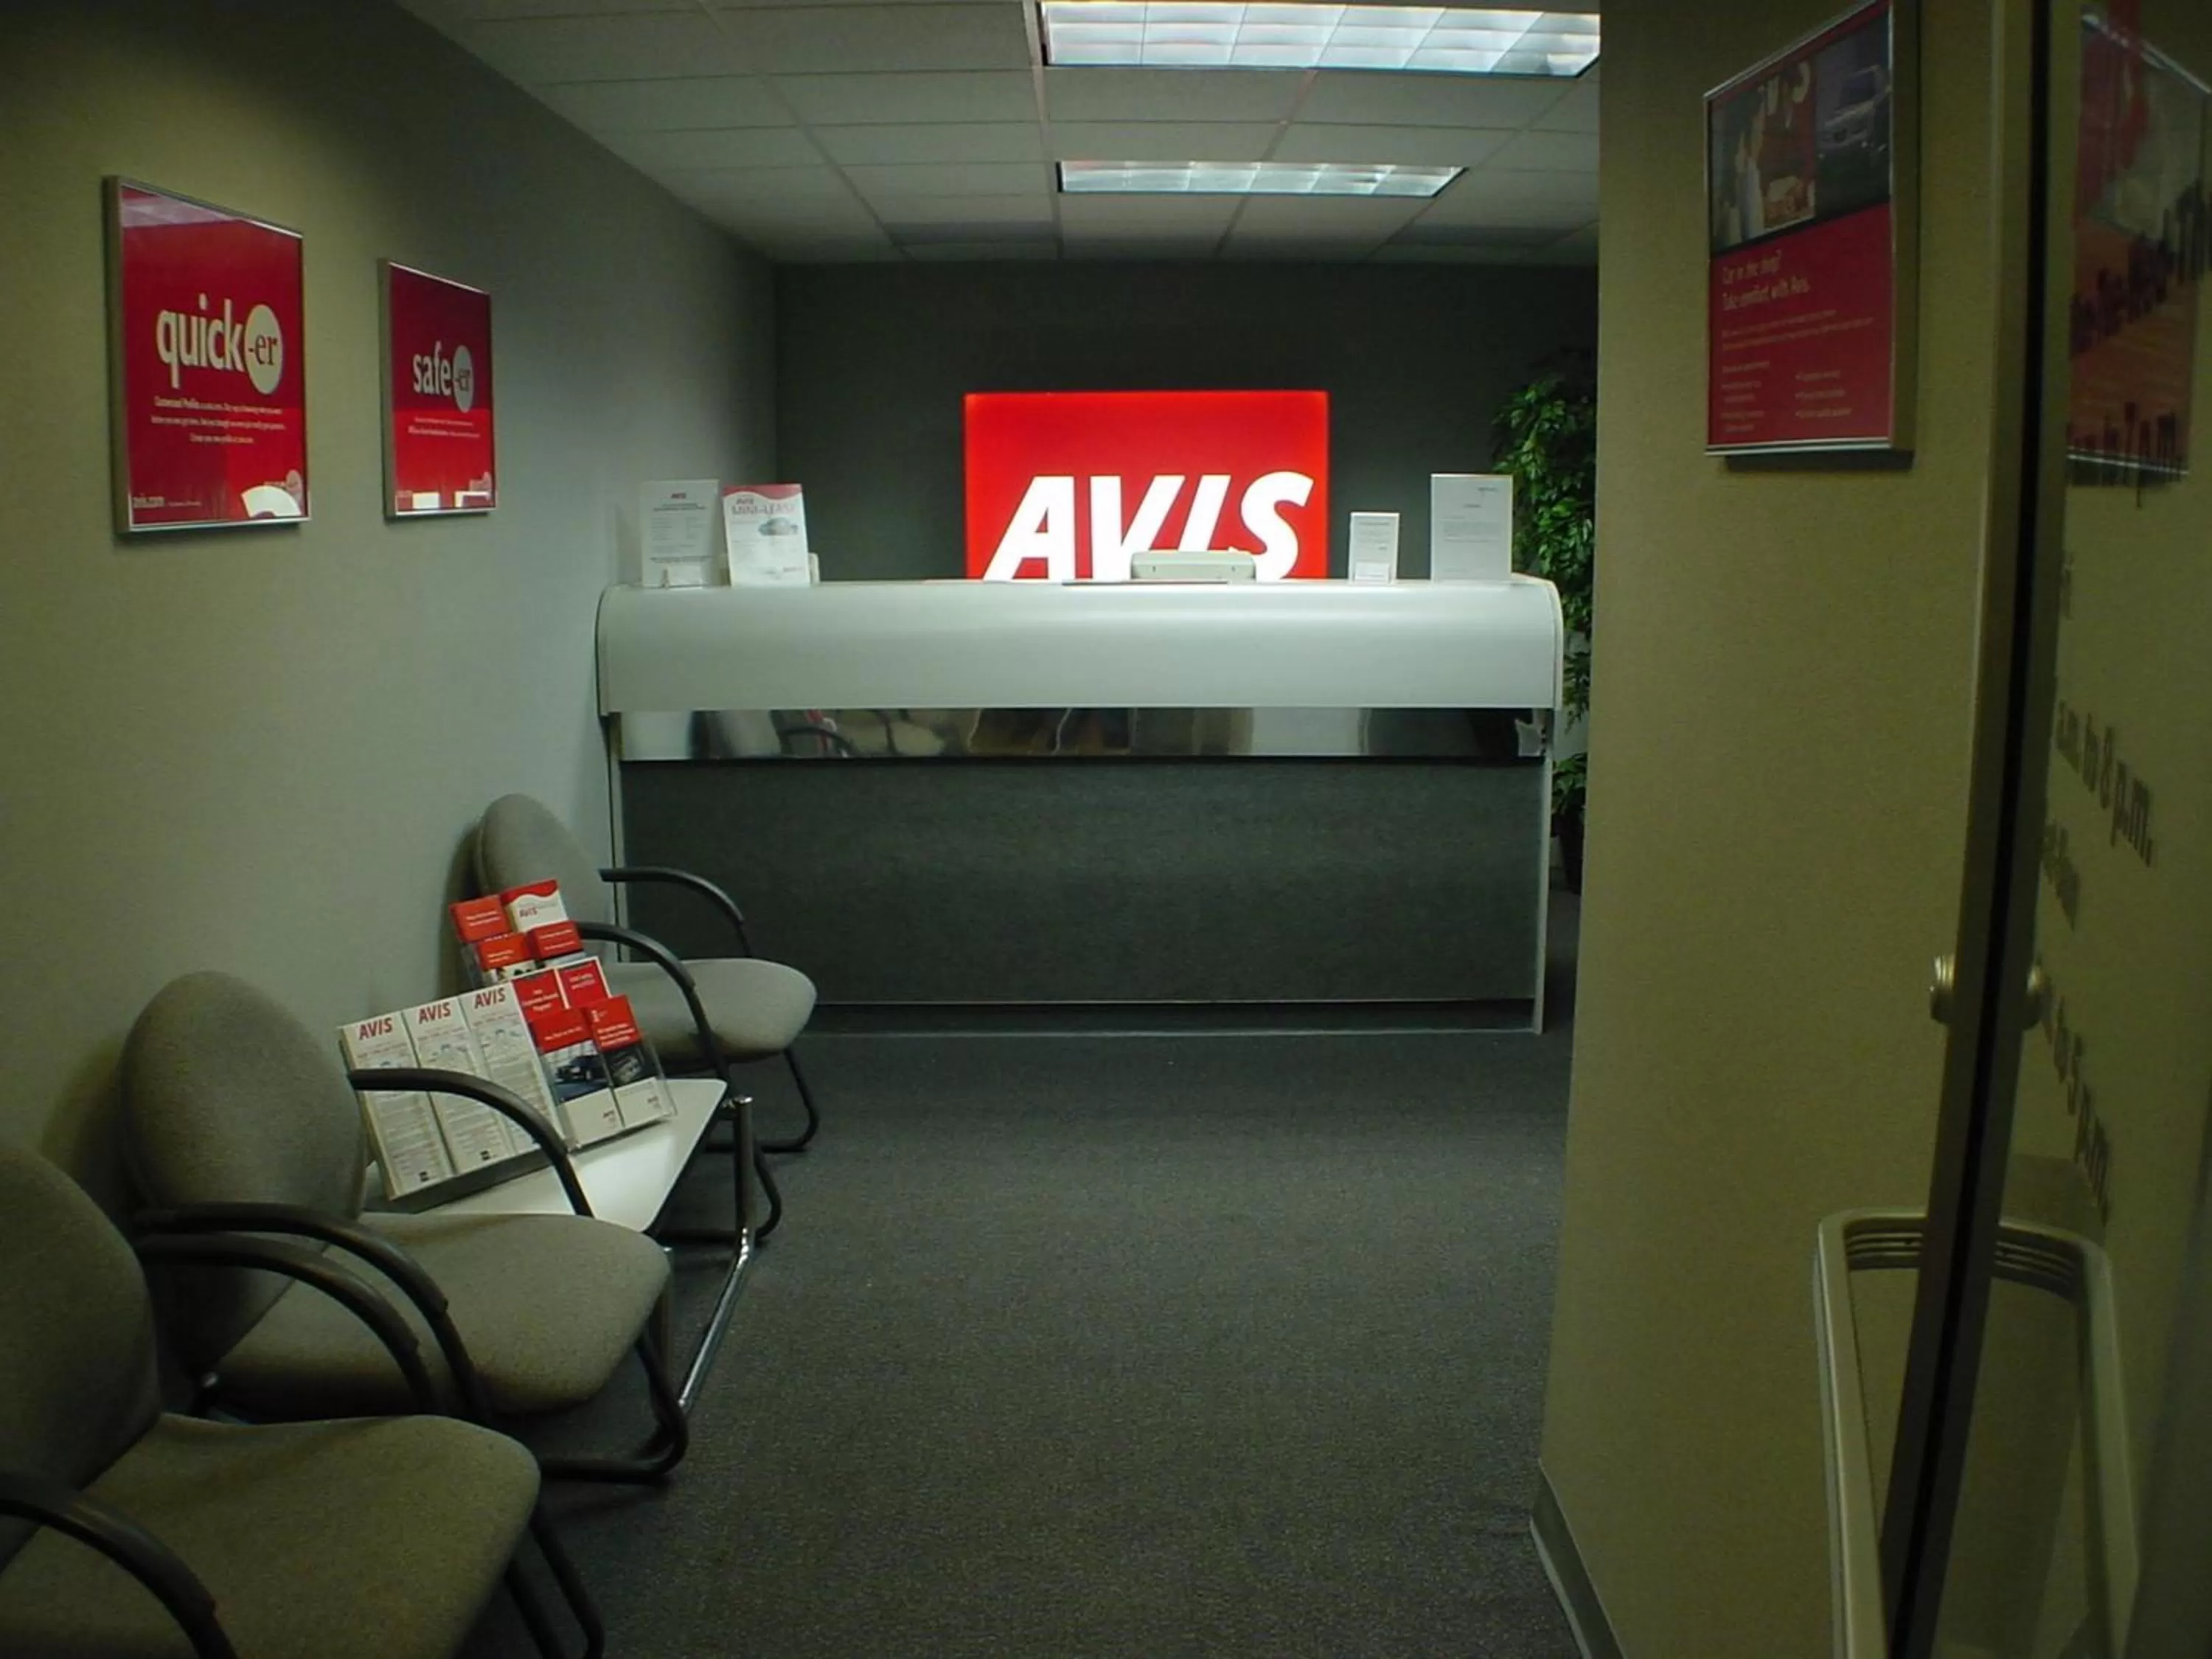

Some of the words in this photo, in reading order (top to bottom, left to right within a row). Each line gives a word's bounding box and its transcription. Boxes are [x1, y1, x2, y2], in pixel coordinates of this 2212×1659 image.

[983, 470, 1315, 581] AVIS
[473, 987, 507, 1010] AVIS
[418, 1001, 451, 1025] AVIS
[358, 1017, 393, 1041] AVIS
